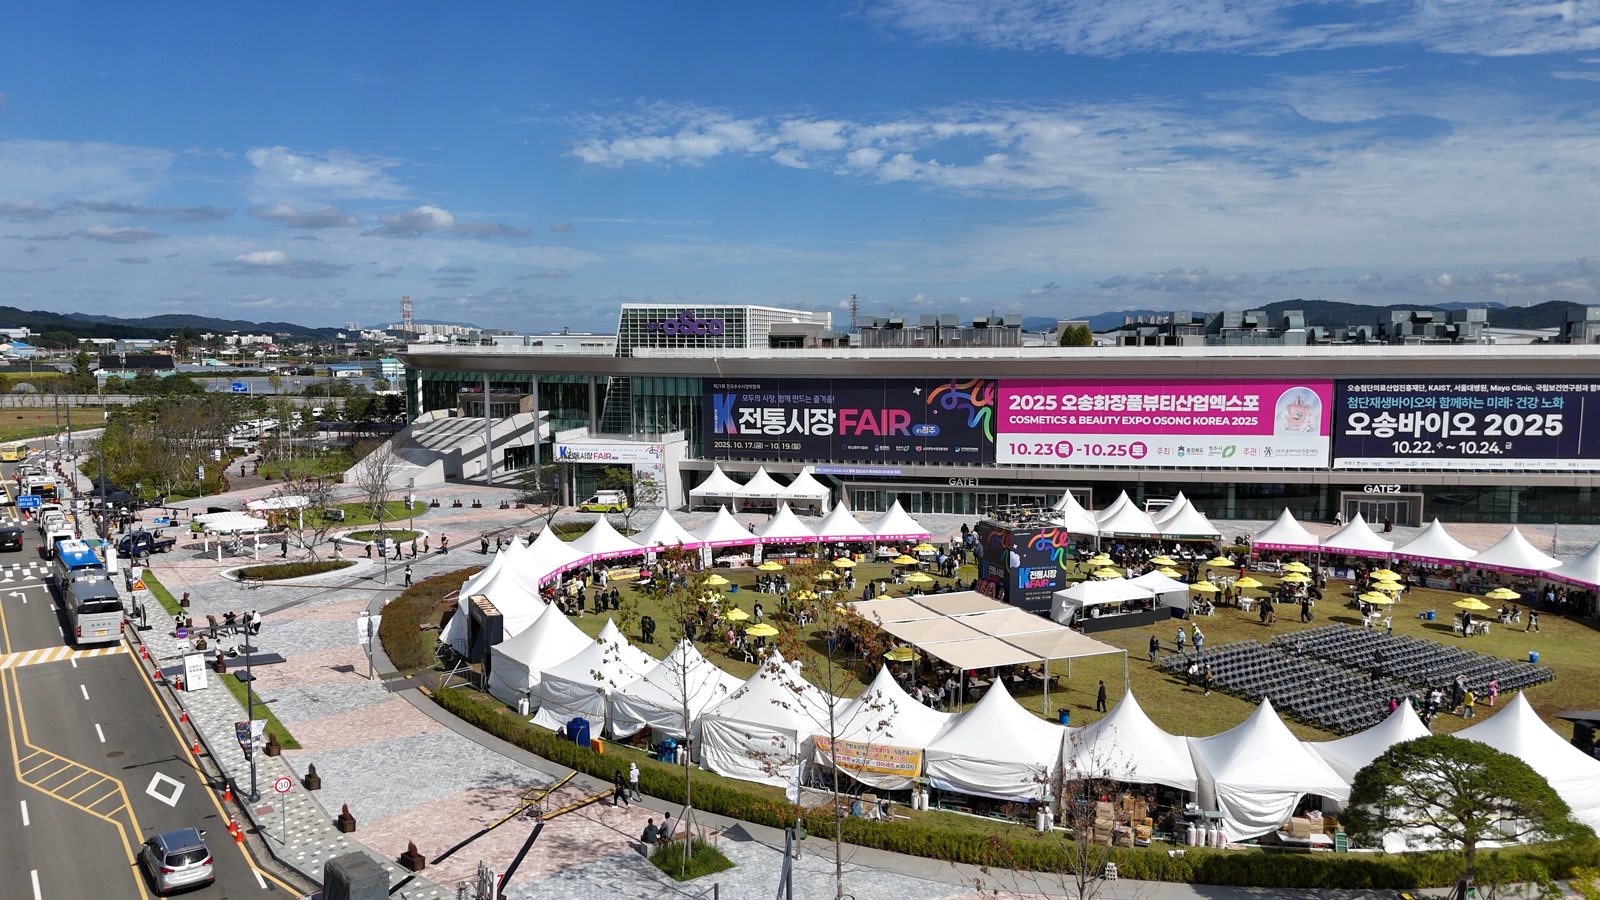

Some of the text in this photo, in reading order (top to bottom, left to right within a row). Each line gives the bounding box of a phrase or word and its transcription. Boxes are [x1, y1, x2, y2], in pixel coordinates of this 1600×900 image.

[1347, 384, 1427, 392] 오송첨단의료산업진흥재단,
[1428, 384, 1452, 392] KAIST,
[1454, 384, 1489, 392] 서울대병원,
[1511, 384, 1534, 392] Clinic,
[1535, 384, 1588, 392] 국립보건연구원과
[762, 395, 777, 403] 시장,
[792, 395, 812, 403] 만드는
[813, 395, 835, 404] 즐거움!
[1008, 394, 1260, 412] 2025 오송화장품뷰티산업엑스포
[1347, 396, 1564, 409] 첨단재생바이오와 함께하는 미래: 건강 노화
[839, 409, 911, 436] FAIR
[1009, 415, 1258, 426] COSMETICS & BEAUTY EXPO OSONG KOREA 2025
[1345, 411, 1563, 438] 오송바이오 2025
[1156, 447, 1170, 455] 주최
[1243, 447, 1257, 456] 주관
[1392, 441, 1435, 454] 10.22.
[1459, 441, 1503, 454] 10.24.
[593, 452, 612, 460] FAIR
[948, 478, 979, 486] GATE1
[1363, 484, 1401, 494] GATE2
[1030, 570, 1057, 579] 전통시장
[1030, 579, 1049, 588] FAIR
[278, 781, 289, 790] 30
